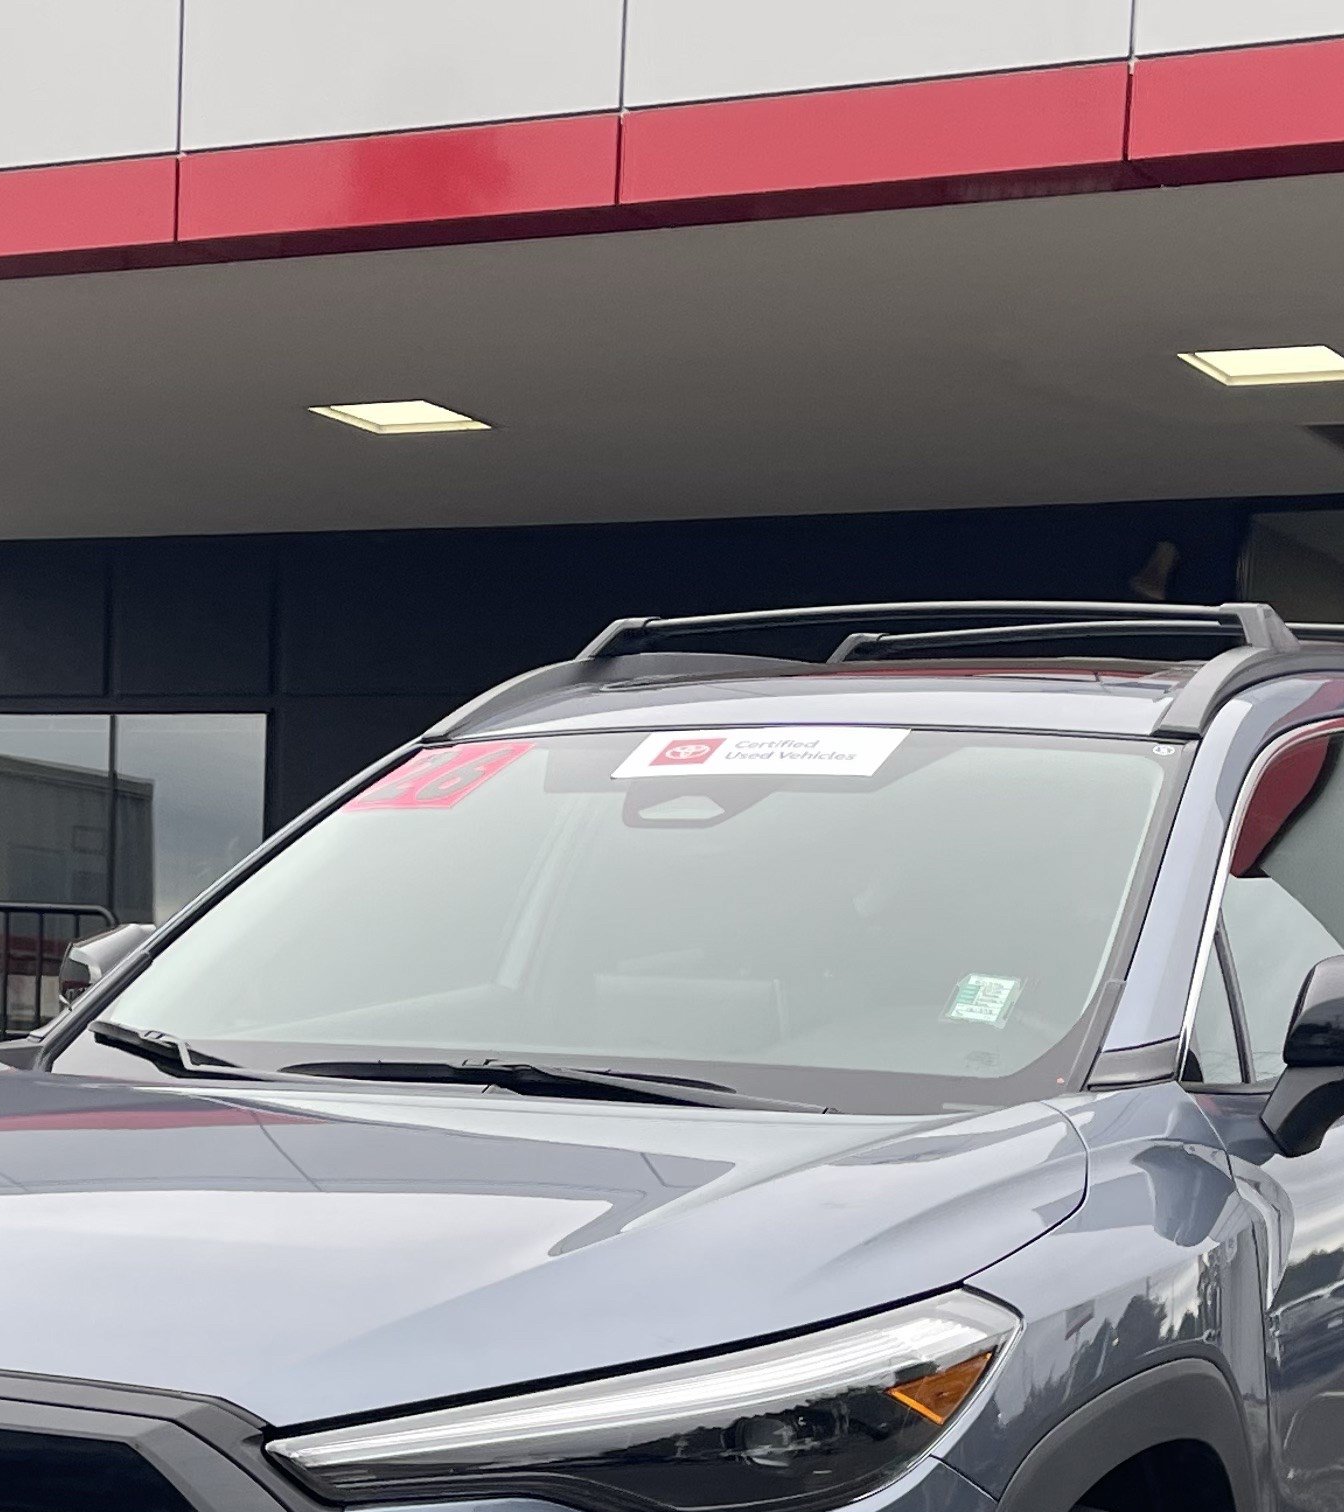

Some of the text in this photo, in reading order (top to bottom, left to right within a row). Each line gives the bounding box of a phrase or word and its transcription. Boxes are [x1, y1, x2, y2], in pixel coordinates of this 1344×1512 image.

[734, 739, 820, 749] Certified
[725, 750, 858, 761] Used Vehicles
